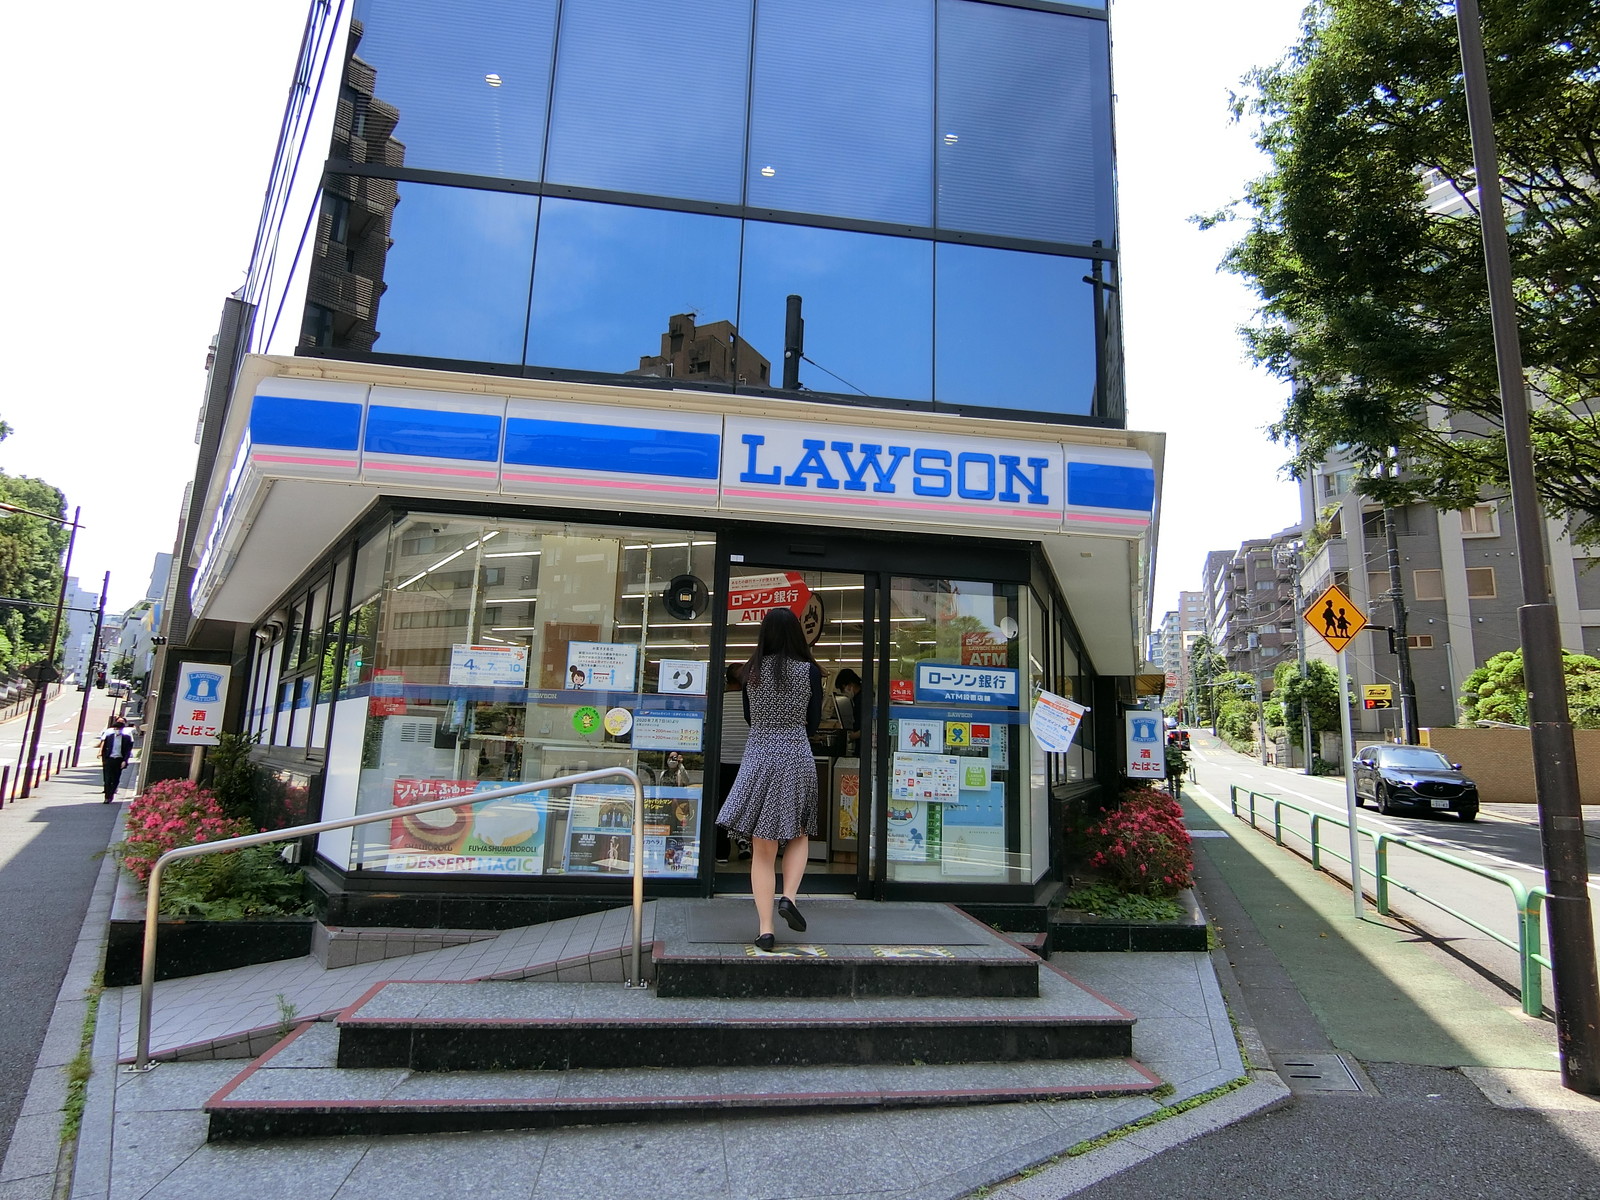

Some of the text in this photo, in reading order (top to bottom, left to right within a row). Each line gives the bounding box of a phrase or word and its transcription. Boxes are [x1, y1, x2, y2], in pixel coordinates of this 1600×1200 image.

[739, 433, 1050, 506] LAWSON
[731, 589, 799, 606] ローソン銀行
[965, 637, 1007, 646] ローソン
[969, 652, 1007, 666] ATM
[928, 671, 1007, 689] ローソン銀行
[944, 692, 991, 702] ATM設置店舗
[1366, 700, 1375, 709] P
[192, 709, 207, 721] 酒
[177, 724, 216, 737] たばこ
[1140, 748, 1151, 759] 酒
[1131, 761, 1161, 771] たばこ
[405, 856, 533, 872] DESSERT MAGIC
